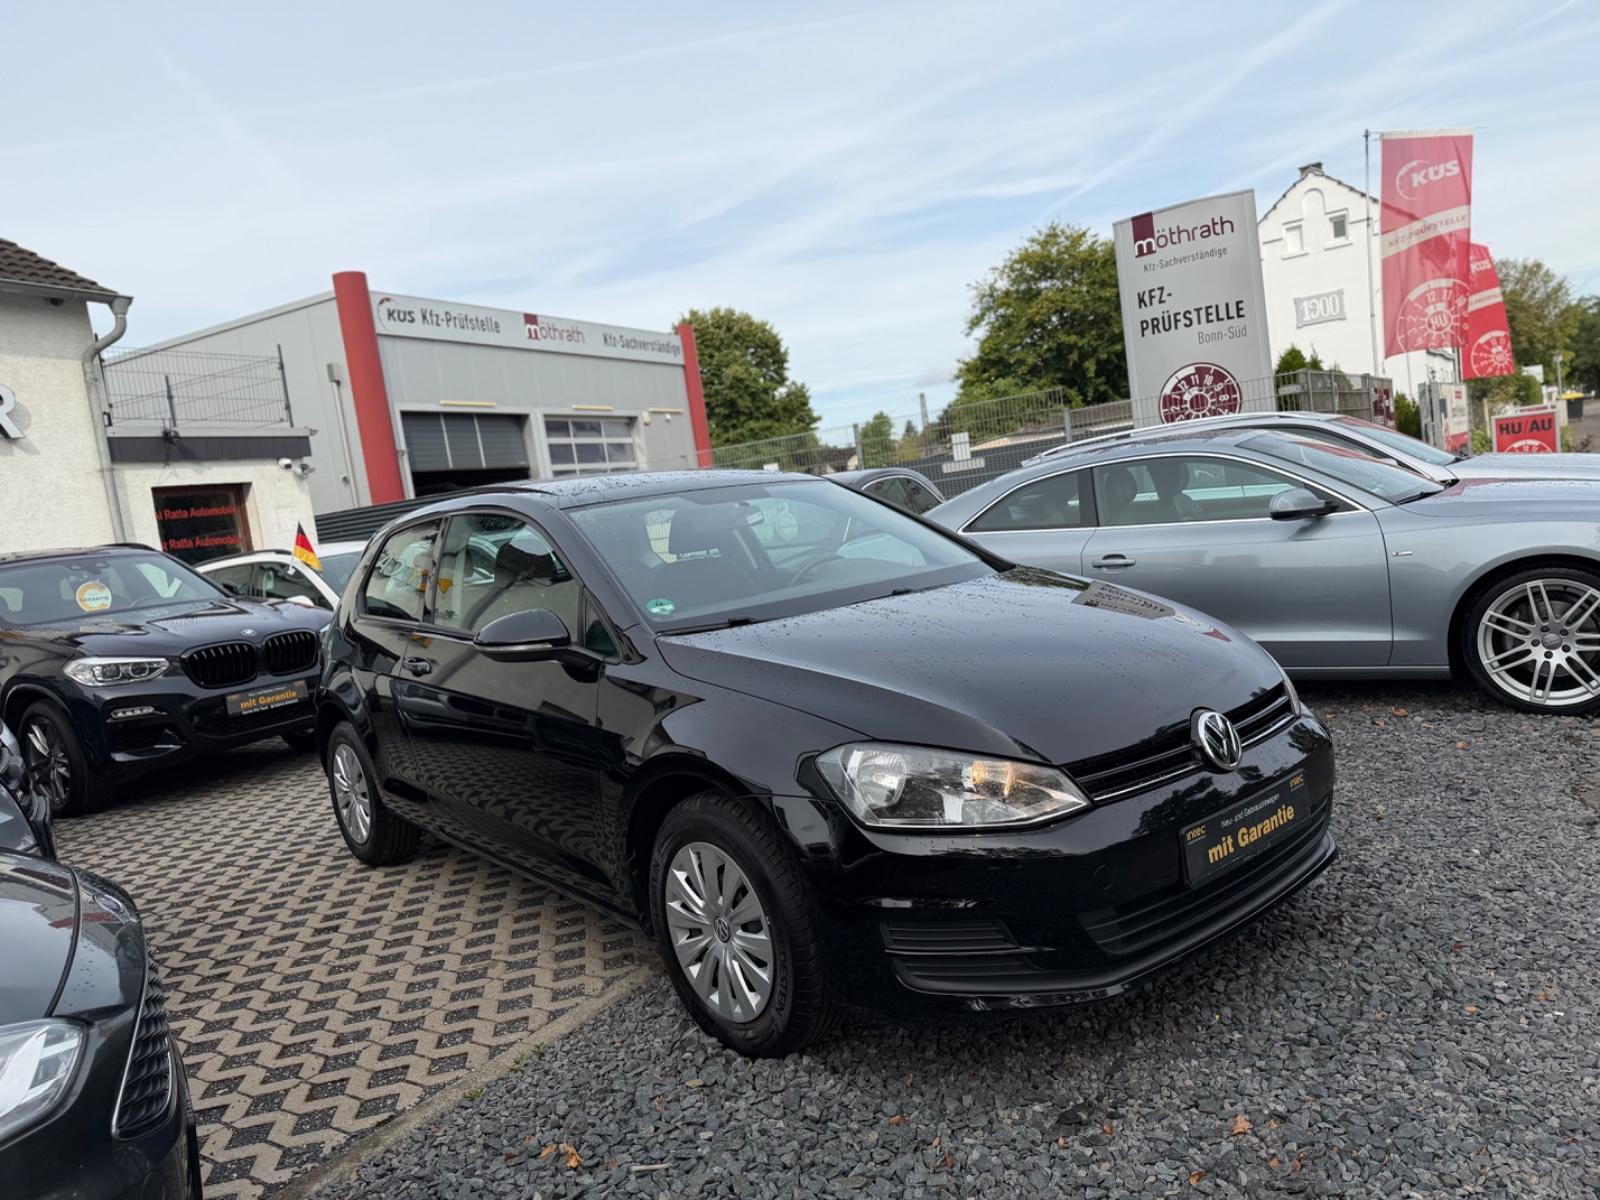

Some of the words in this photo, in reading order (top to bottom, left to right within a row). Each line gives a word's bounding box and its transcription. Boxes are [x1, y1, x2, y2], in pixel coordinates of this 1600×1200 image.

[1411, 160, 1460, 188] KÜS
[1134, 215, 1235, 258] möthrath
[1388, 214, 1467, 247] KFZ-PRÜFSTELLE
[1143, 246, 1228, 273] Kfz-Sachverständige
[1137, 286, 1172, 309] KFZ-
[1300, 294, 1340, 321] 1900
[420, 308, 501, 334] Kfz-Prüfstelle
[524, 318, 586, 344] möthrath
[1140, 300, 1246, 338] PRÜFSTELLE
[1430, 312, 1449, 330] HU
[602, 332, 681, 358] Kfz-Sachverständige
[1197, 324, 1247, 345] Bonn-Süd
[164, 509, 188, 520] Ratta
[169, 539, 193, 551] Ratta
[240, 698, 257, 709] mit
[258, 689, 297, 705] Garantie
[1208, 834, 1235, 864] mit
[1237, 804, 1295, 848] Garantie
